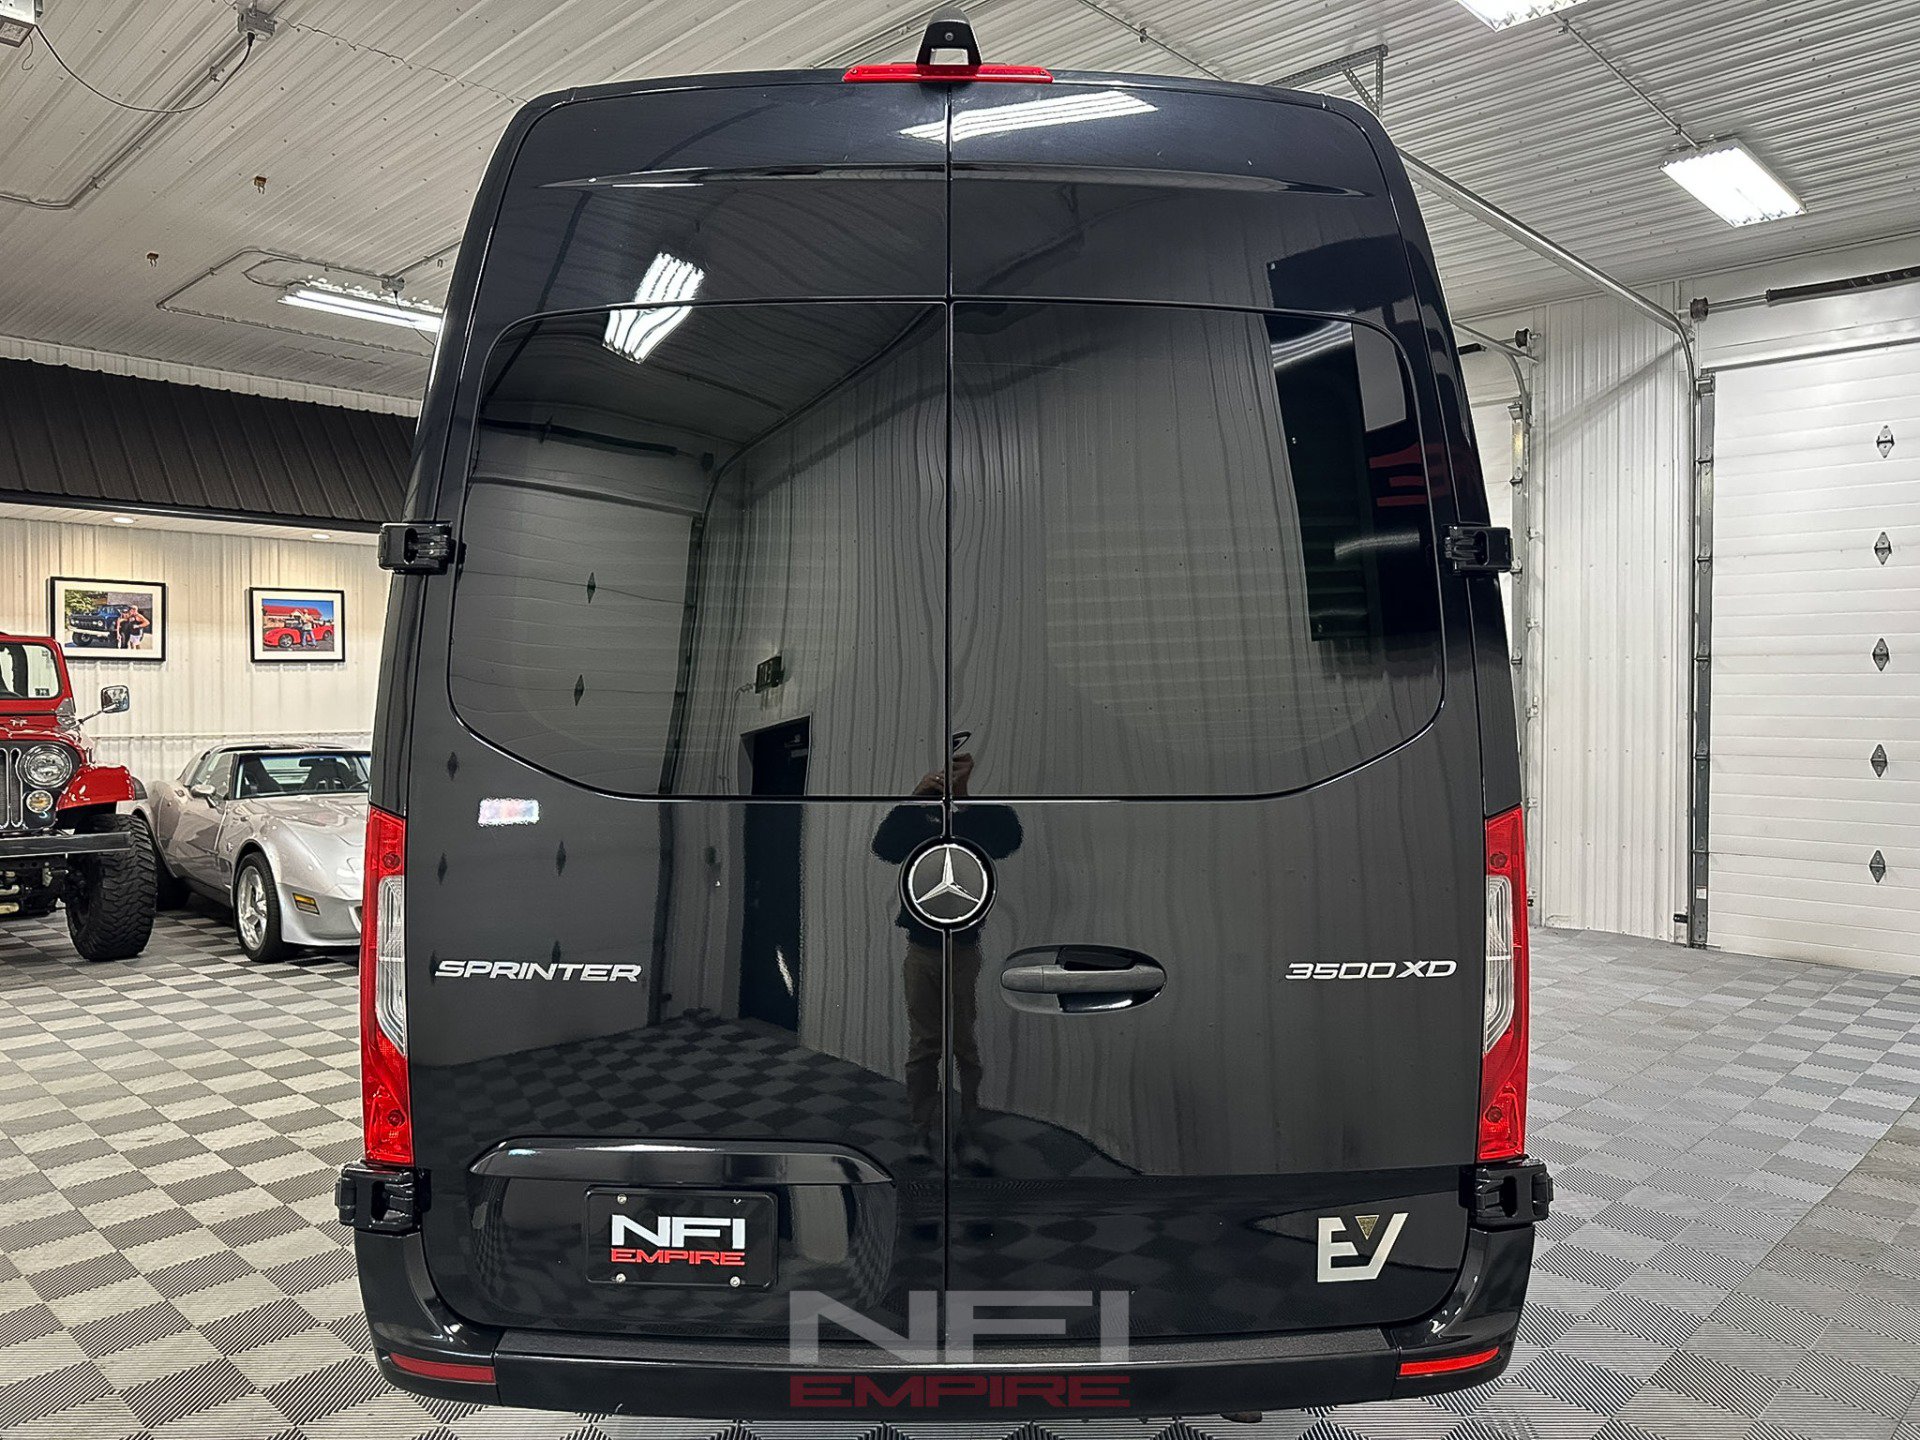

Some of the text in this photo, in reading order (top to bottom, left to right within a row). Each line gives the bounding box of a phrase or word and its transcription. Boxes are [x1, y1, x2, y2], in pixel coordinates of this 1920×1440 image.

[435, 960, 643, 983] SPRINTER
[611, 1214, 746, 1250] NFI
[611, 1248, 746, 1266] EMPIRE
